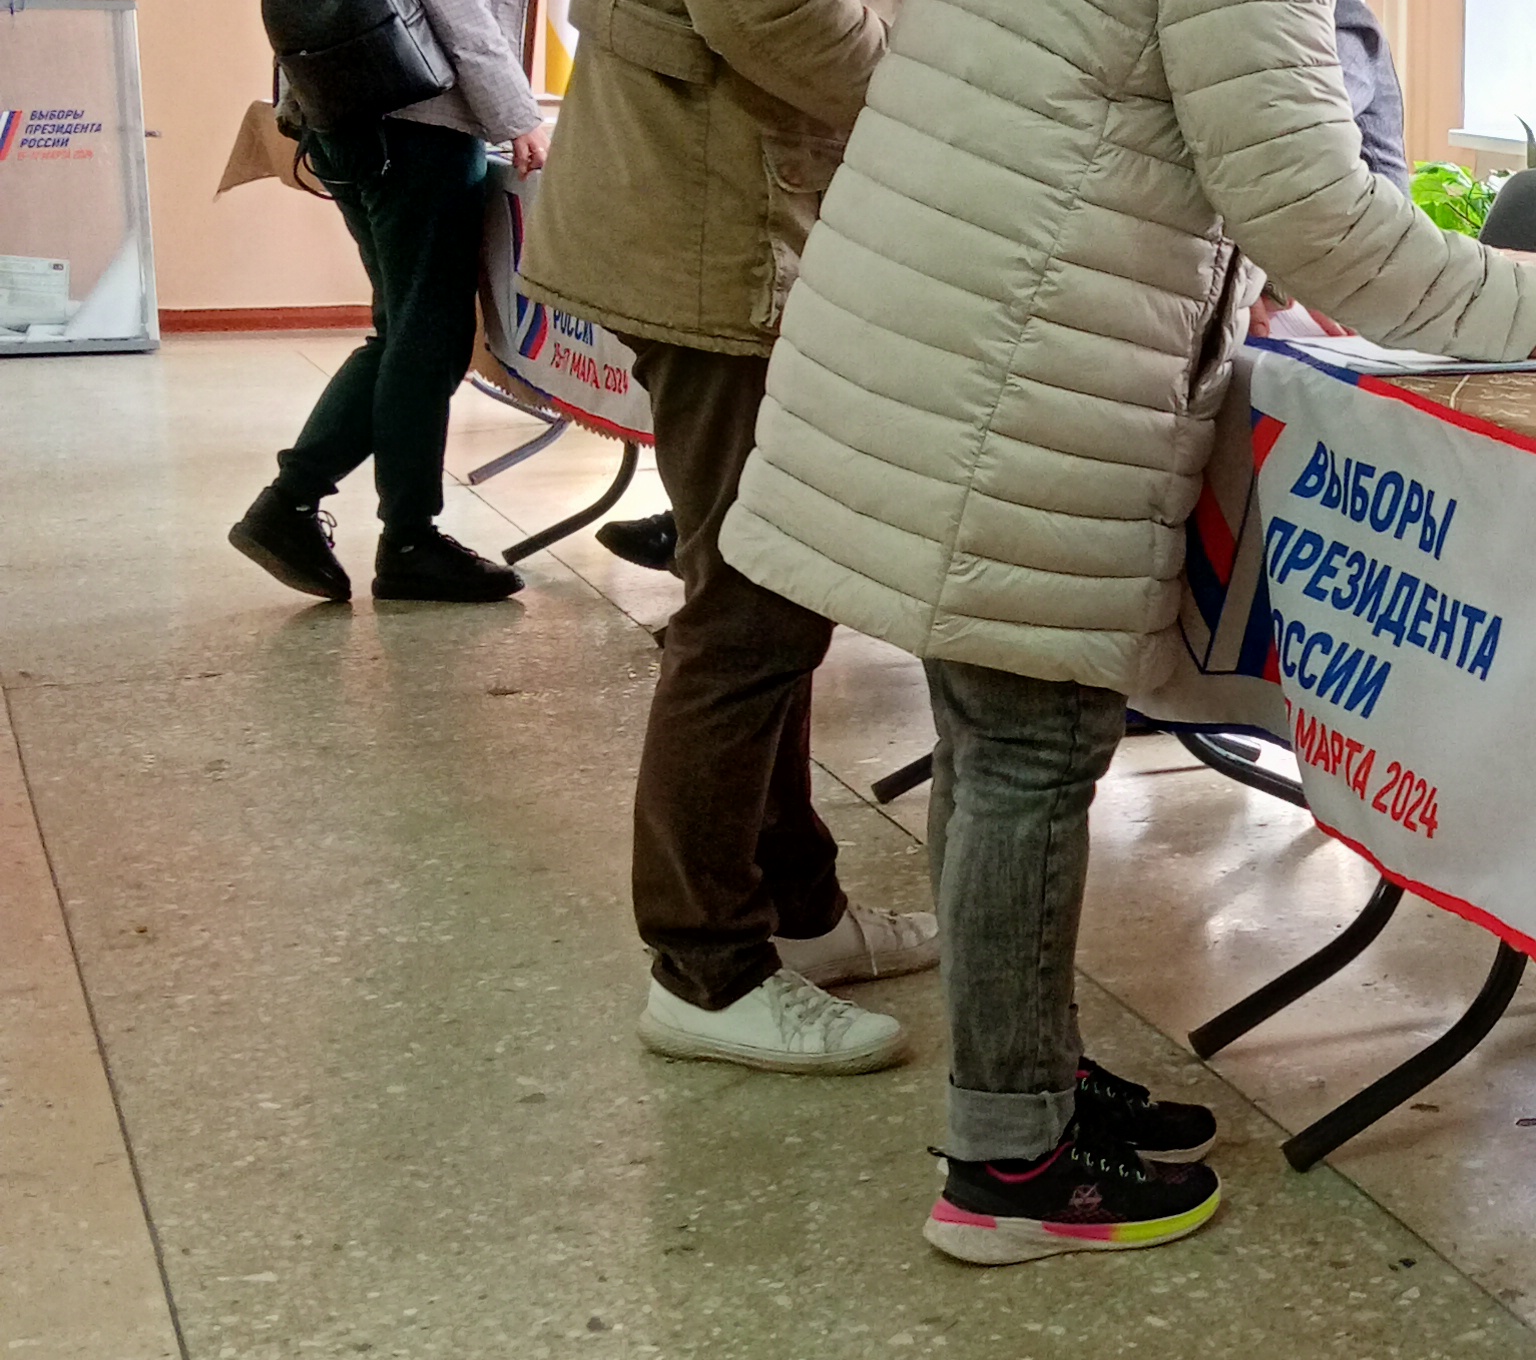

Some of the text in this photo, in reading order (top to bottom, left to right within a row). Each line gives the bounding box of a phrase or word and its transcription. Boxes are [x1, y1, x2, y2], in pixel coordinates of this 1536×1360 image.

[20, 137, 70, 149] РОССИИ
[25, 123, 103, 135] ПРЕЗИДЕНТА
[30, 109, 85, 121] ВЫБОРЫ
[1290, 440, 1457, 561] ВЫБОРЫ
[1266, 516, 1503, 682] ПРЕЗИДЕНТА
[1273, 608, 1392, 719] ОССИИ
[1294, 707, 1439, 839] МАРТА 2024
